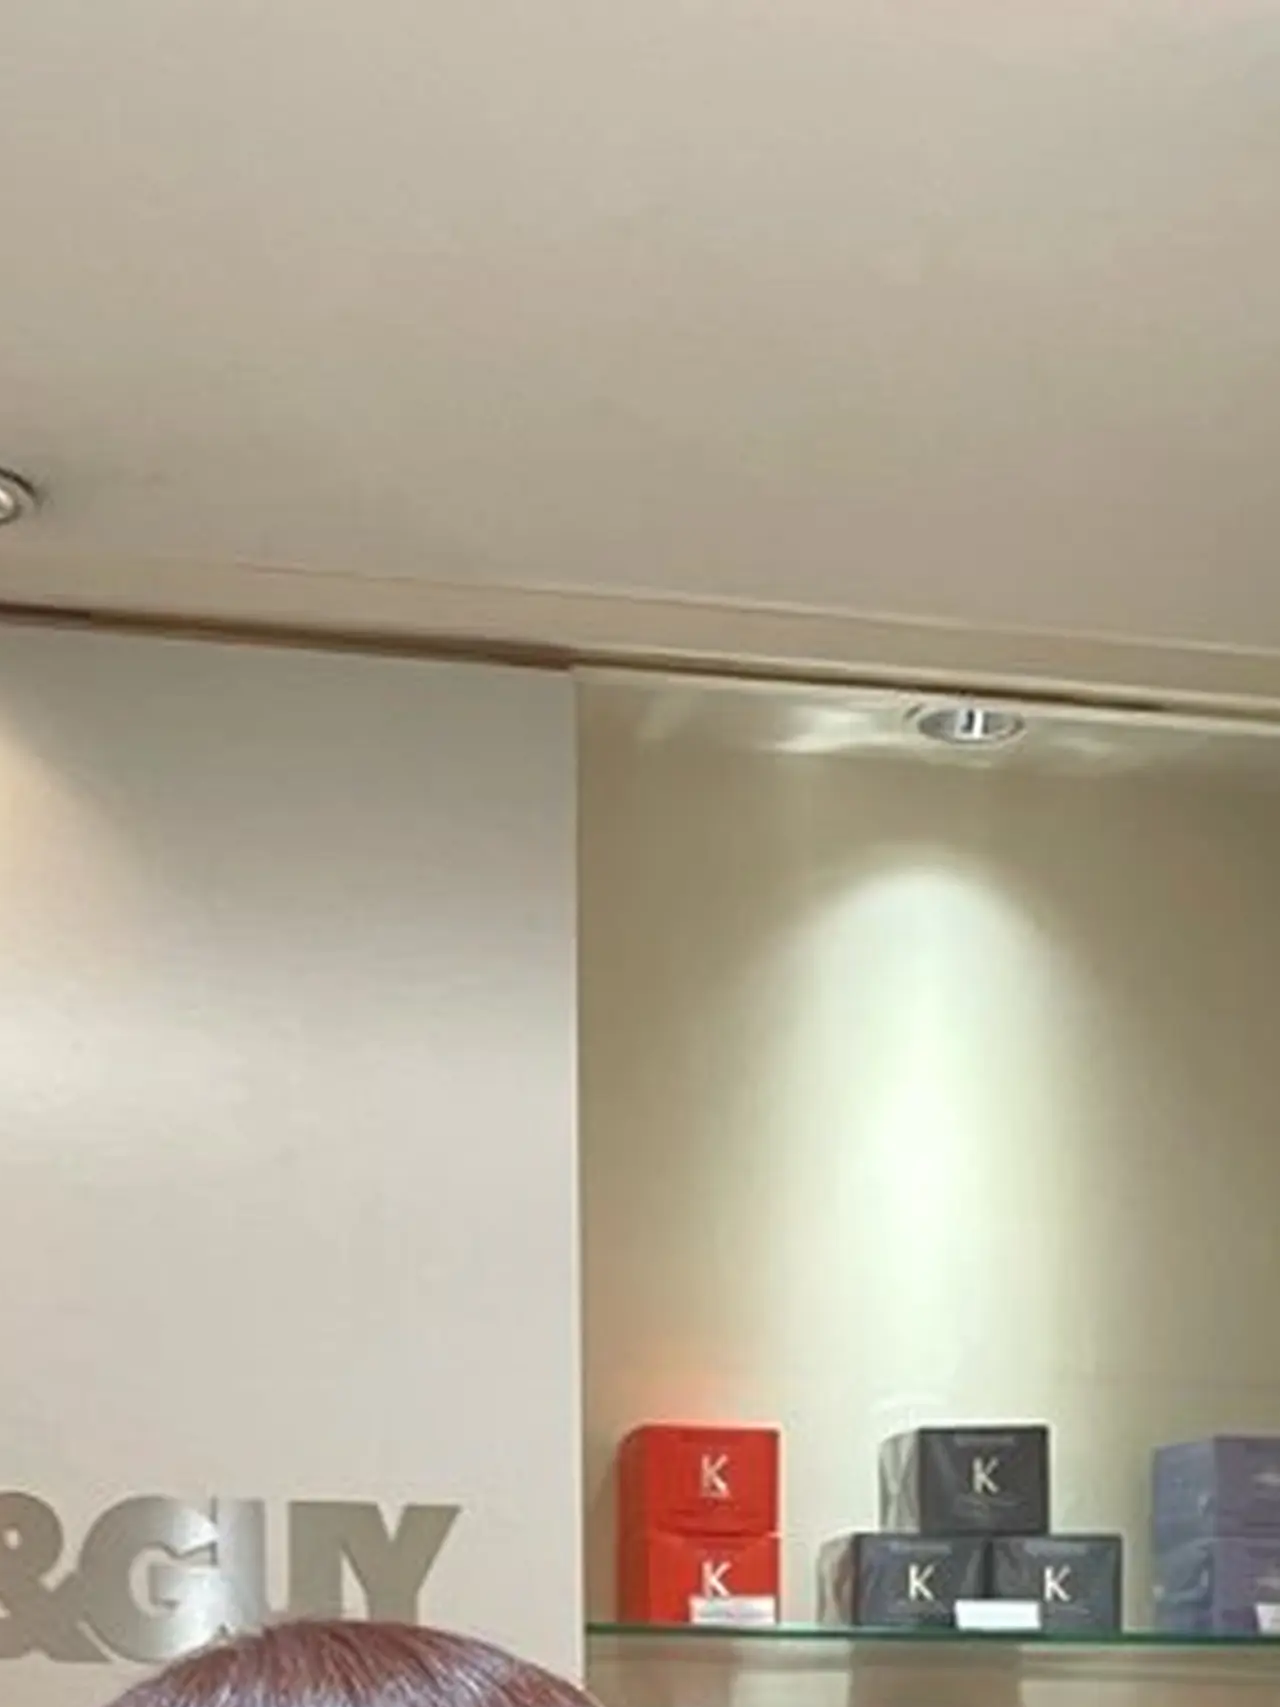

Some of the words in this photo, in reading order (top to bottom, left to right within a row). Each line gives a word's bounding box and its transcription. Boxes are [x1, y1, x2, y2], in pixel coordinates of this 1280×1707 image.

[701, 1453, 731, 1498] K
[972, 1456, 1000, 1494] K
[701, 1560, 732, 1598] K
[908, 1562, 935, 1601] K
[1044, 1565, 1071, 1602] K
